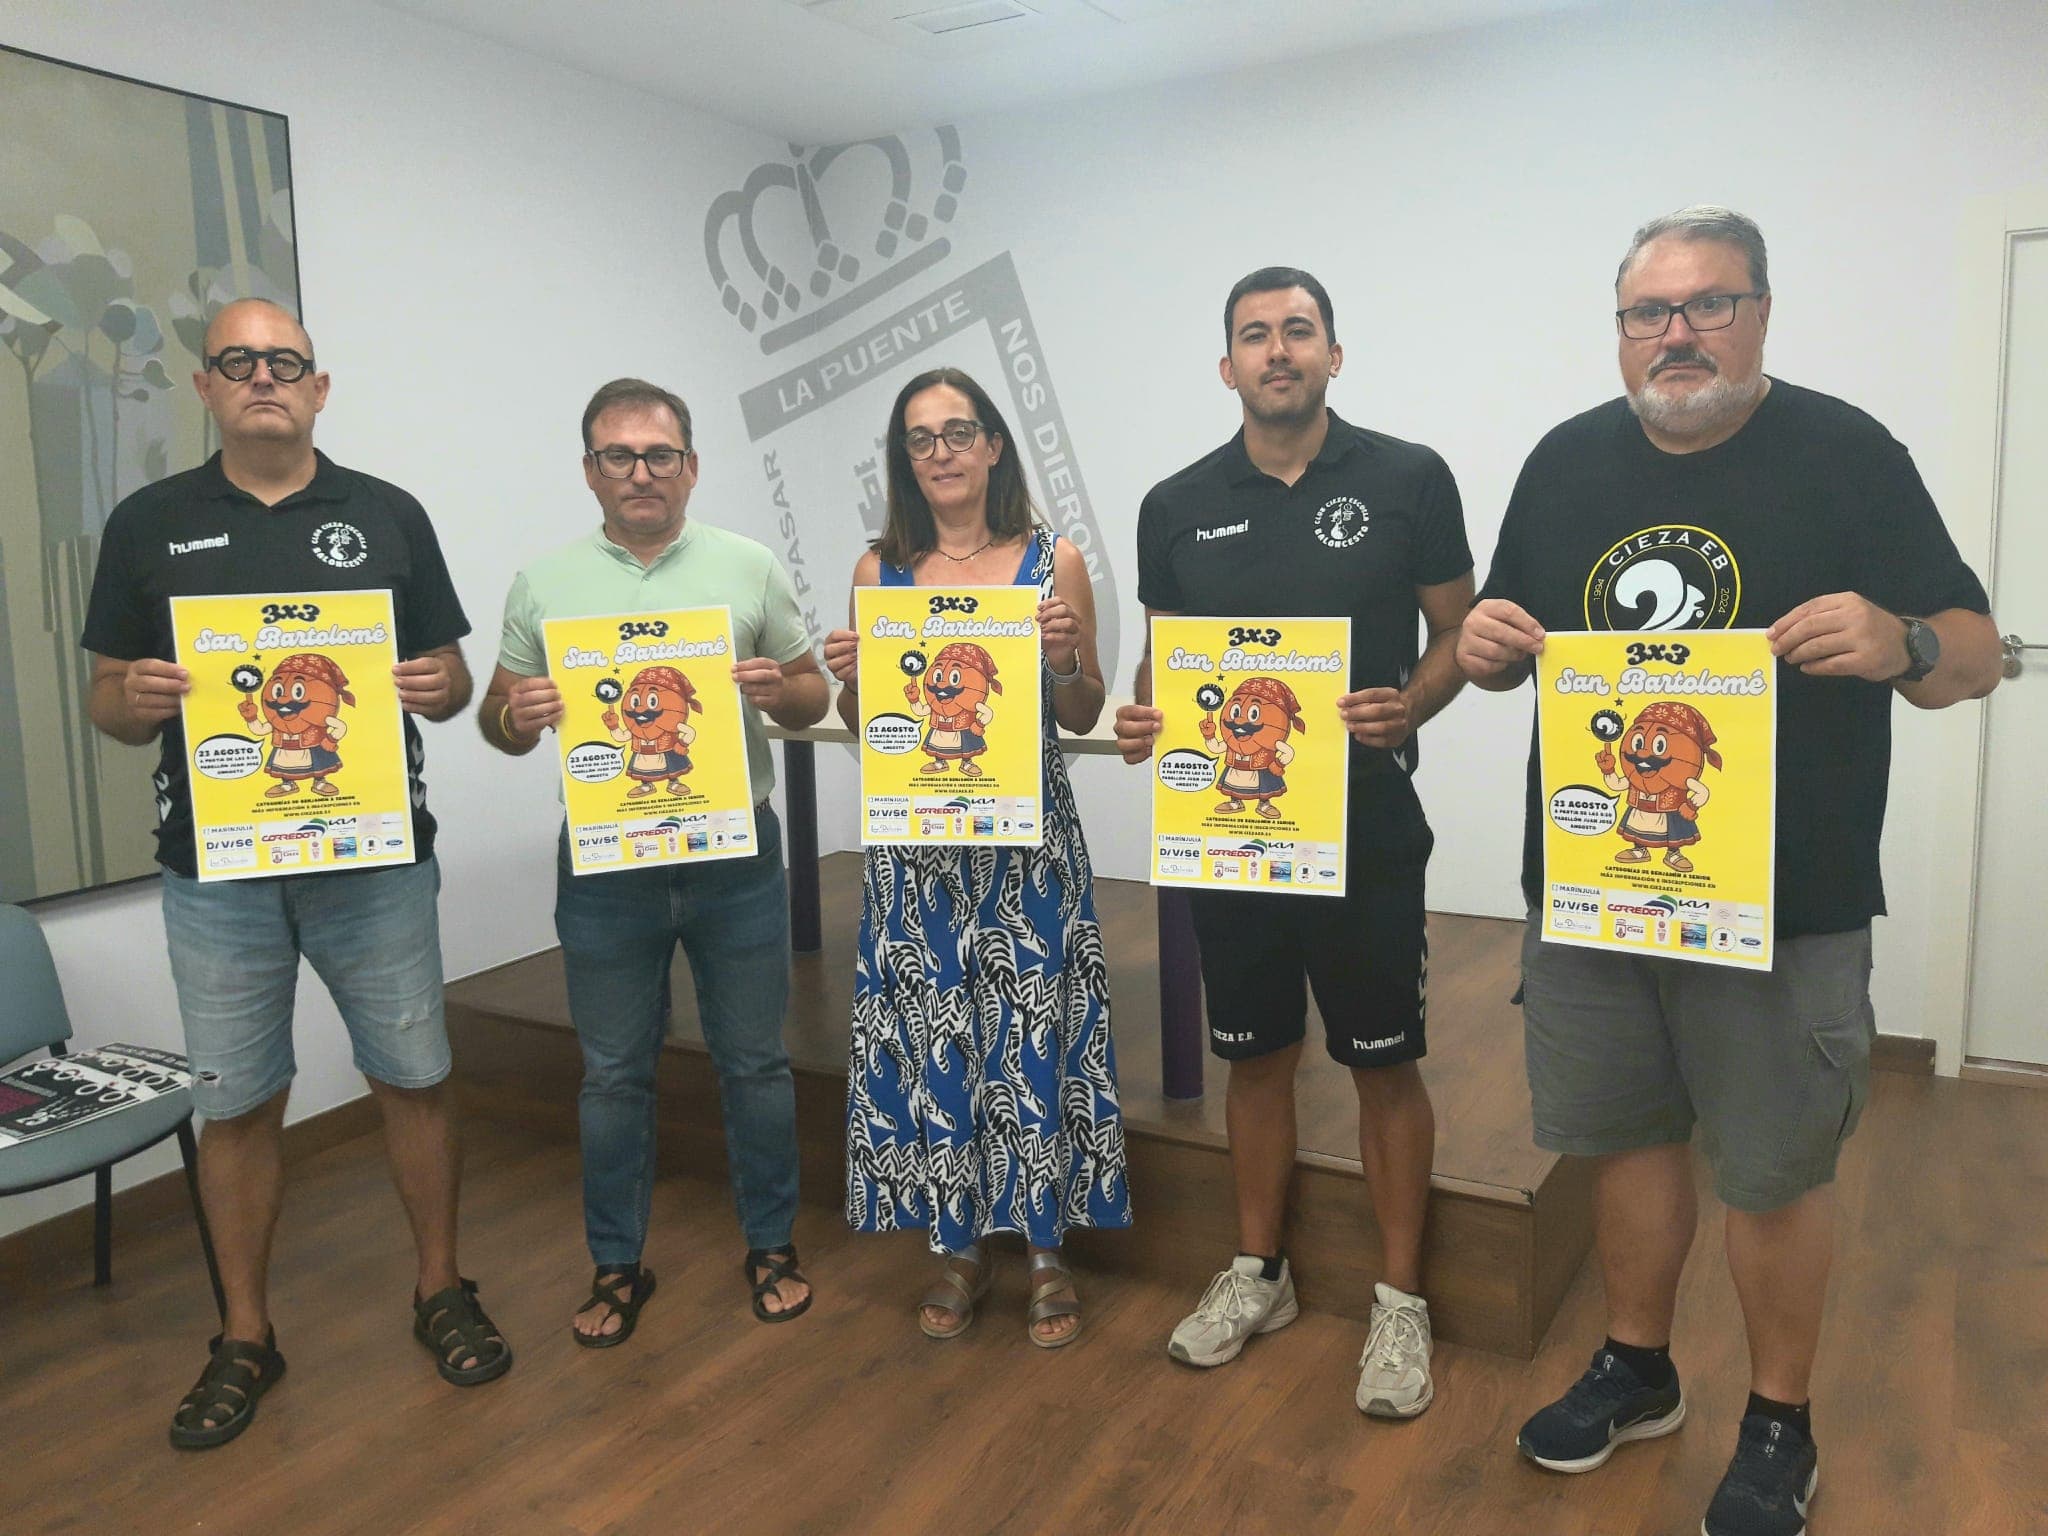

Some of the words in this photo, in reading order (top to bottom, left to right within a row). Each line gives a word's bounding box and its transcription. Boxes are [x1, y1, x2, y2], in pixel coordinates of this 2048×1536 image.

[778, 377, 815, 413] LA
[819, 290, 971, 391] PUENTE
[1000, 317, 1047, 413] NOS
[1032, 420, 1105, 585] DIERON
[763, 448, 812, 597] PASAR
[1196, 519, 1249, 542] hummel
[169, 532, 230, 556] hummel
[1314, 525, 1369, 548] BALONCESTO
[1608, 530, 1690, 566] CIEZA
[1700, 540, 1729, 570] EB
[929, 595, 978, 614] 3x3
[1718, 587, 1730, 614] 2024
[261, 603, 321, 625] 3x3
[618, 620, 670, 641] 3x3
[872, 616, 916, 639] San
[922, 615, 1034, 638] Bartolomé
[1228, 627, 1281, 647] 3x3
[193, 628, 248, 654] San
[254, 623, 387, 651] Bartolomé
[562, 646, 609, 669] San
[614, 635, 728, 665] Bartolomé
[1167, 648, 1214, 672] San
[1220, 648, 1342, 674] Bartolomé
[1625, 642, 1691, 666] 3x3
[1555, 667, 1611, 696] San
[1617, 667, 1768, 695] Bartolomé
[213, 747, 253, 756] AGOSTO
[582, 752, 616, 761] AGOSTO
[1568, 800, 1607, 810] AGOSTO
[328, 817, 356, 825] KIA
[682, 814, 706, 822] KIA
[261, 831, 316, 842] CORREDOR
[625, 827, 672, 838] CORREDOR
[1207, 849, 1255, 857] CORREDOR
[1268, 841, 1294, 849] KIA
[1607, 903, 1664, 916] CORREDOR
[1679, 898, 1710, 909] KIA
[1353, 1031, 1405, 1050] hummel
